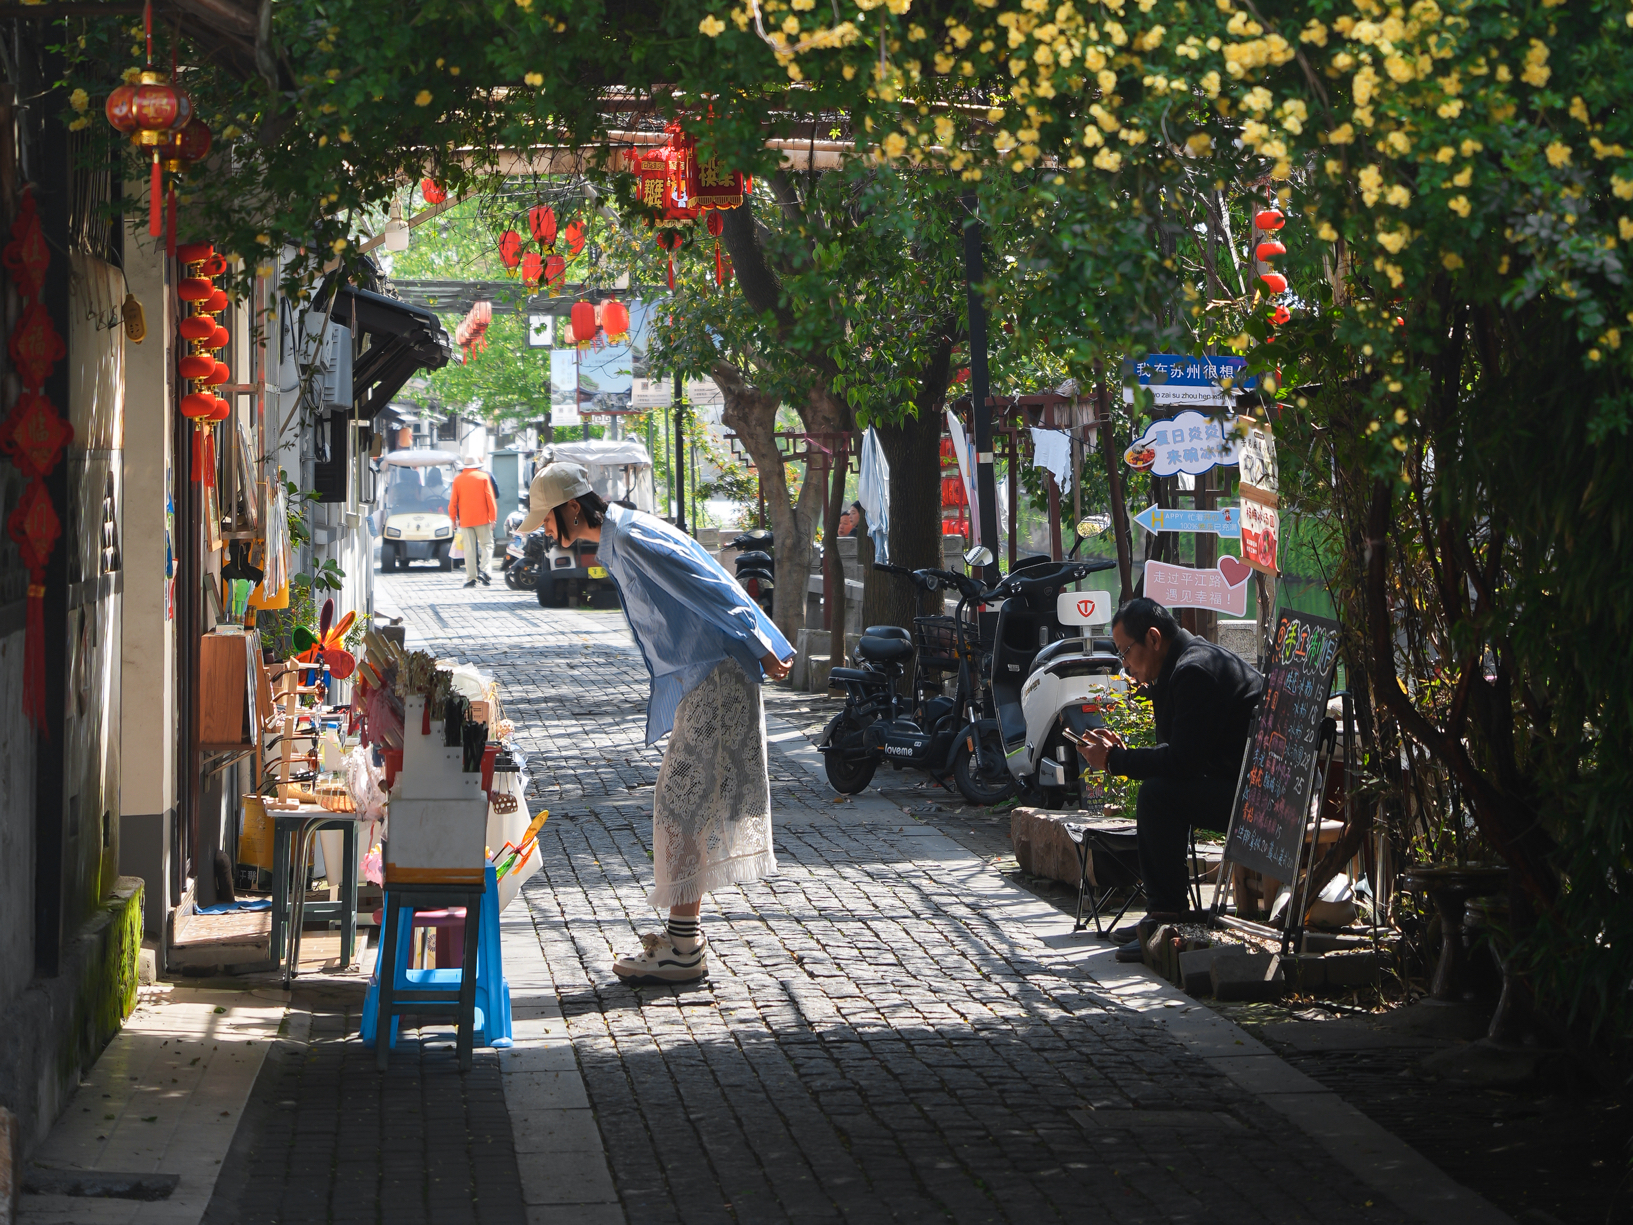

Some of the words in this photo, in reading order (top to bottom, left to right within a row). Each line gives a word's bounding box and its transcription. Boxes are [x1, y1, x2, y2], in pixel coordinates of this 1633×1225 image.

[1136, 362, 1244, 379] 我在苏州很想
[1155, 424, 1219, 446] 夏日炎炎
[1153, 571, 1221, 588] 走过平江路
[1285, 623, 1336, 670] 手工制作
[884, 743, 913, 756] loveme
